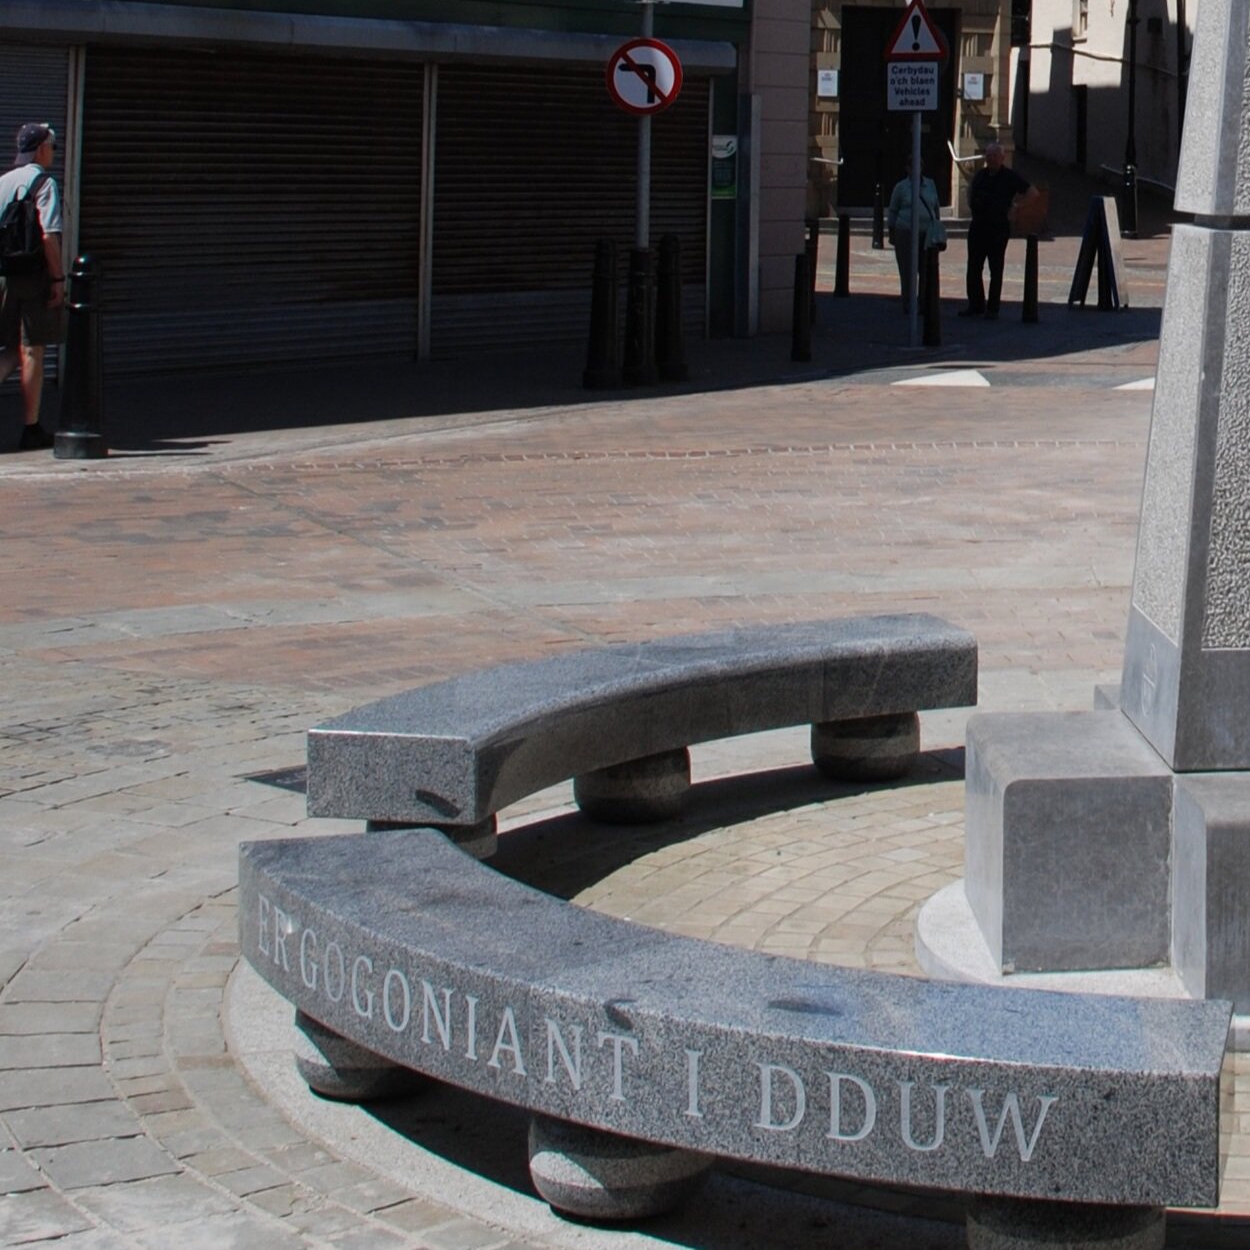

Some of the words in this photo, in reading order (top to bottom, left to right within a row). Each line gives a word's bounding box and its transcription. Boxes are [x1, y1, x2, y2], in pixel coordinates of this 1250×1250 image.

[891, 65, 935, 76] Cerbydau
[910, 76, 935, 85] blaen
[894, 87, 930, 96] Vehicles
[899, 97, 926, 106] ahead
[257, 892, 291, 972] ER
[300, 928, 640, 1102] GOGONIANT
[684, 1049, 704, 1118] I
[754, 1061, 1060, 1162] DDUW
